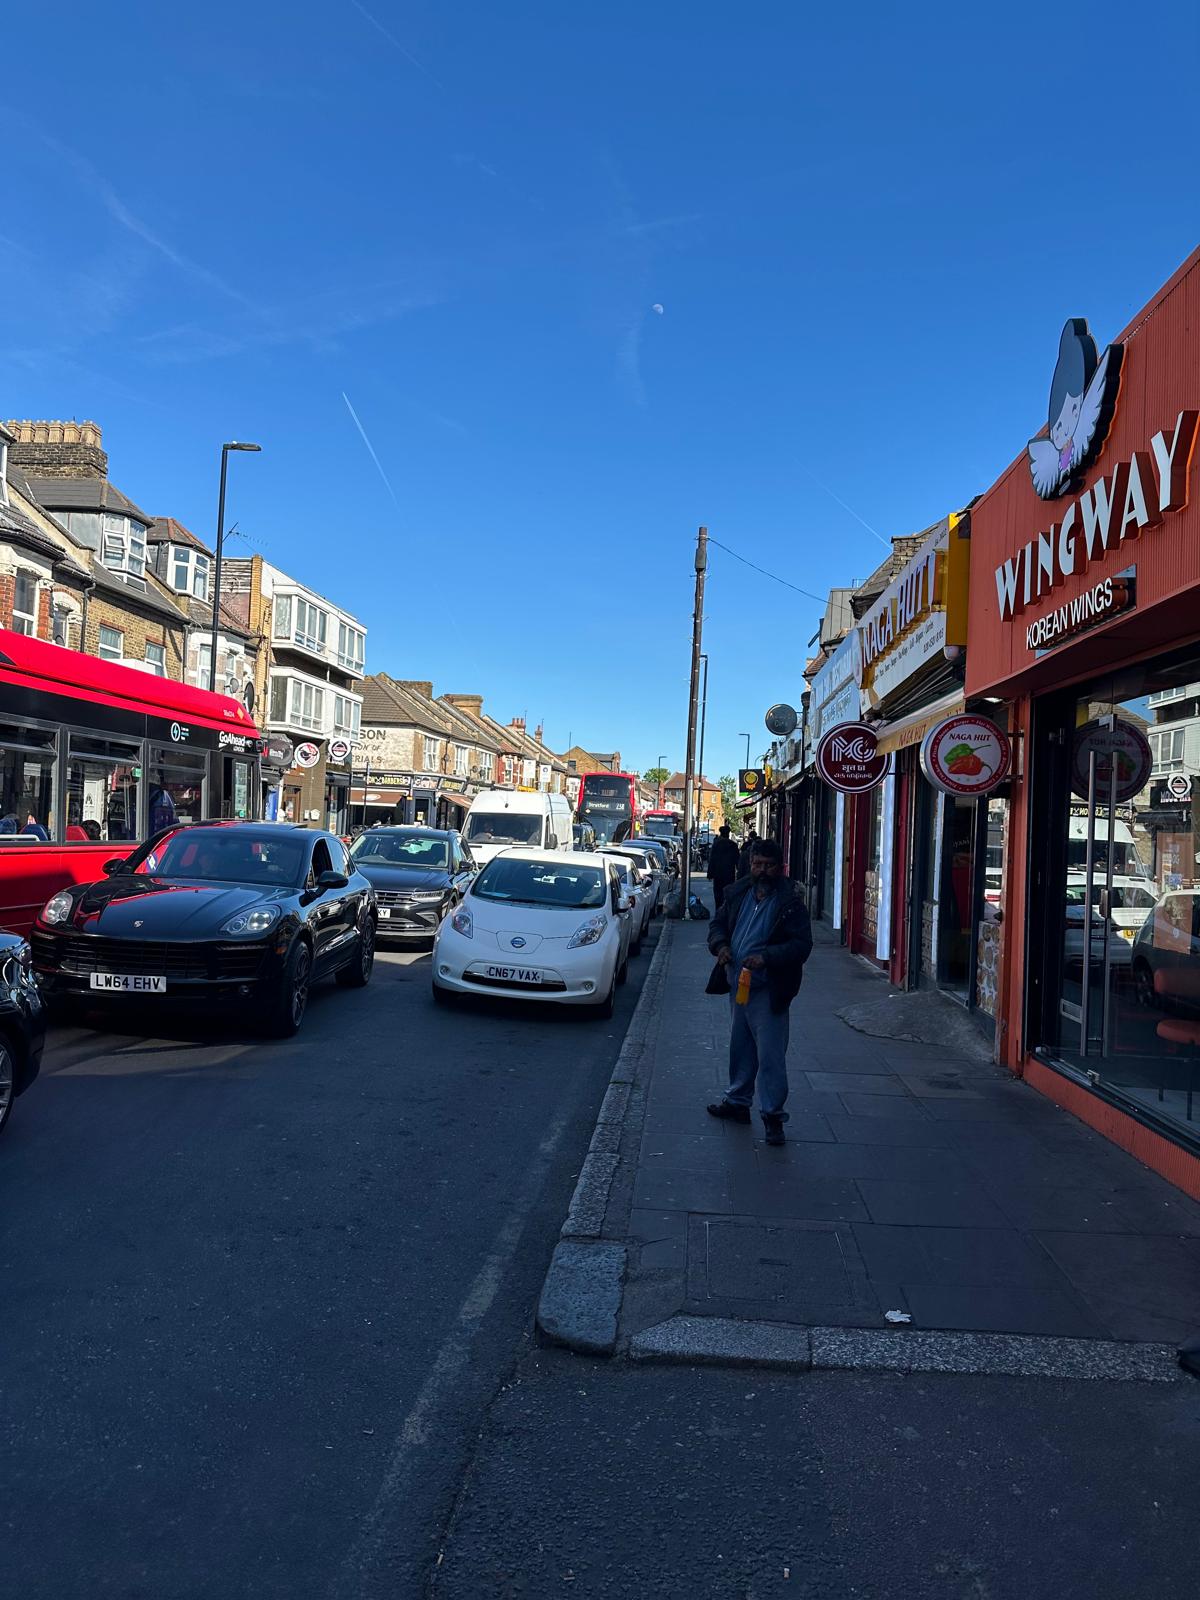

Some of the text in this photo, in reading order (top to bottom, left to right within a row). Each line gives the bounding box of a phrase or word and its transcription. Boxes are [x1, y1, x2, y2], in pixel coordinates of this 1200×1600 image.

[995, 411, 1186, 621] WINGWAY
[863, 600, 894, 669] NAGA
[1026, 577, 1113, 650] KOREAN WINGS
[949, 733, 992, 742] NAGA HUT
[96, 974, 160, 990] LW64 EHV
[488, 967, 538, 981] CN67 VAX
